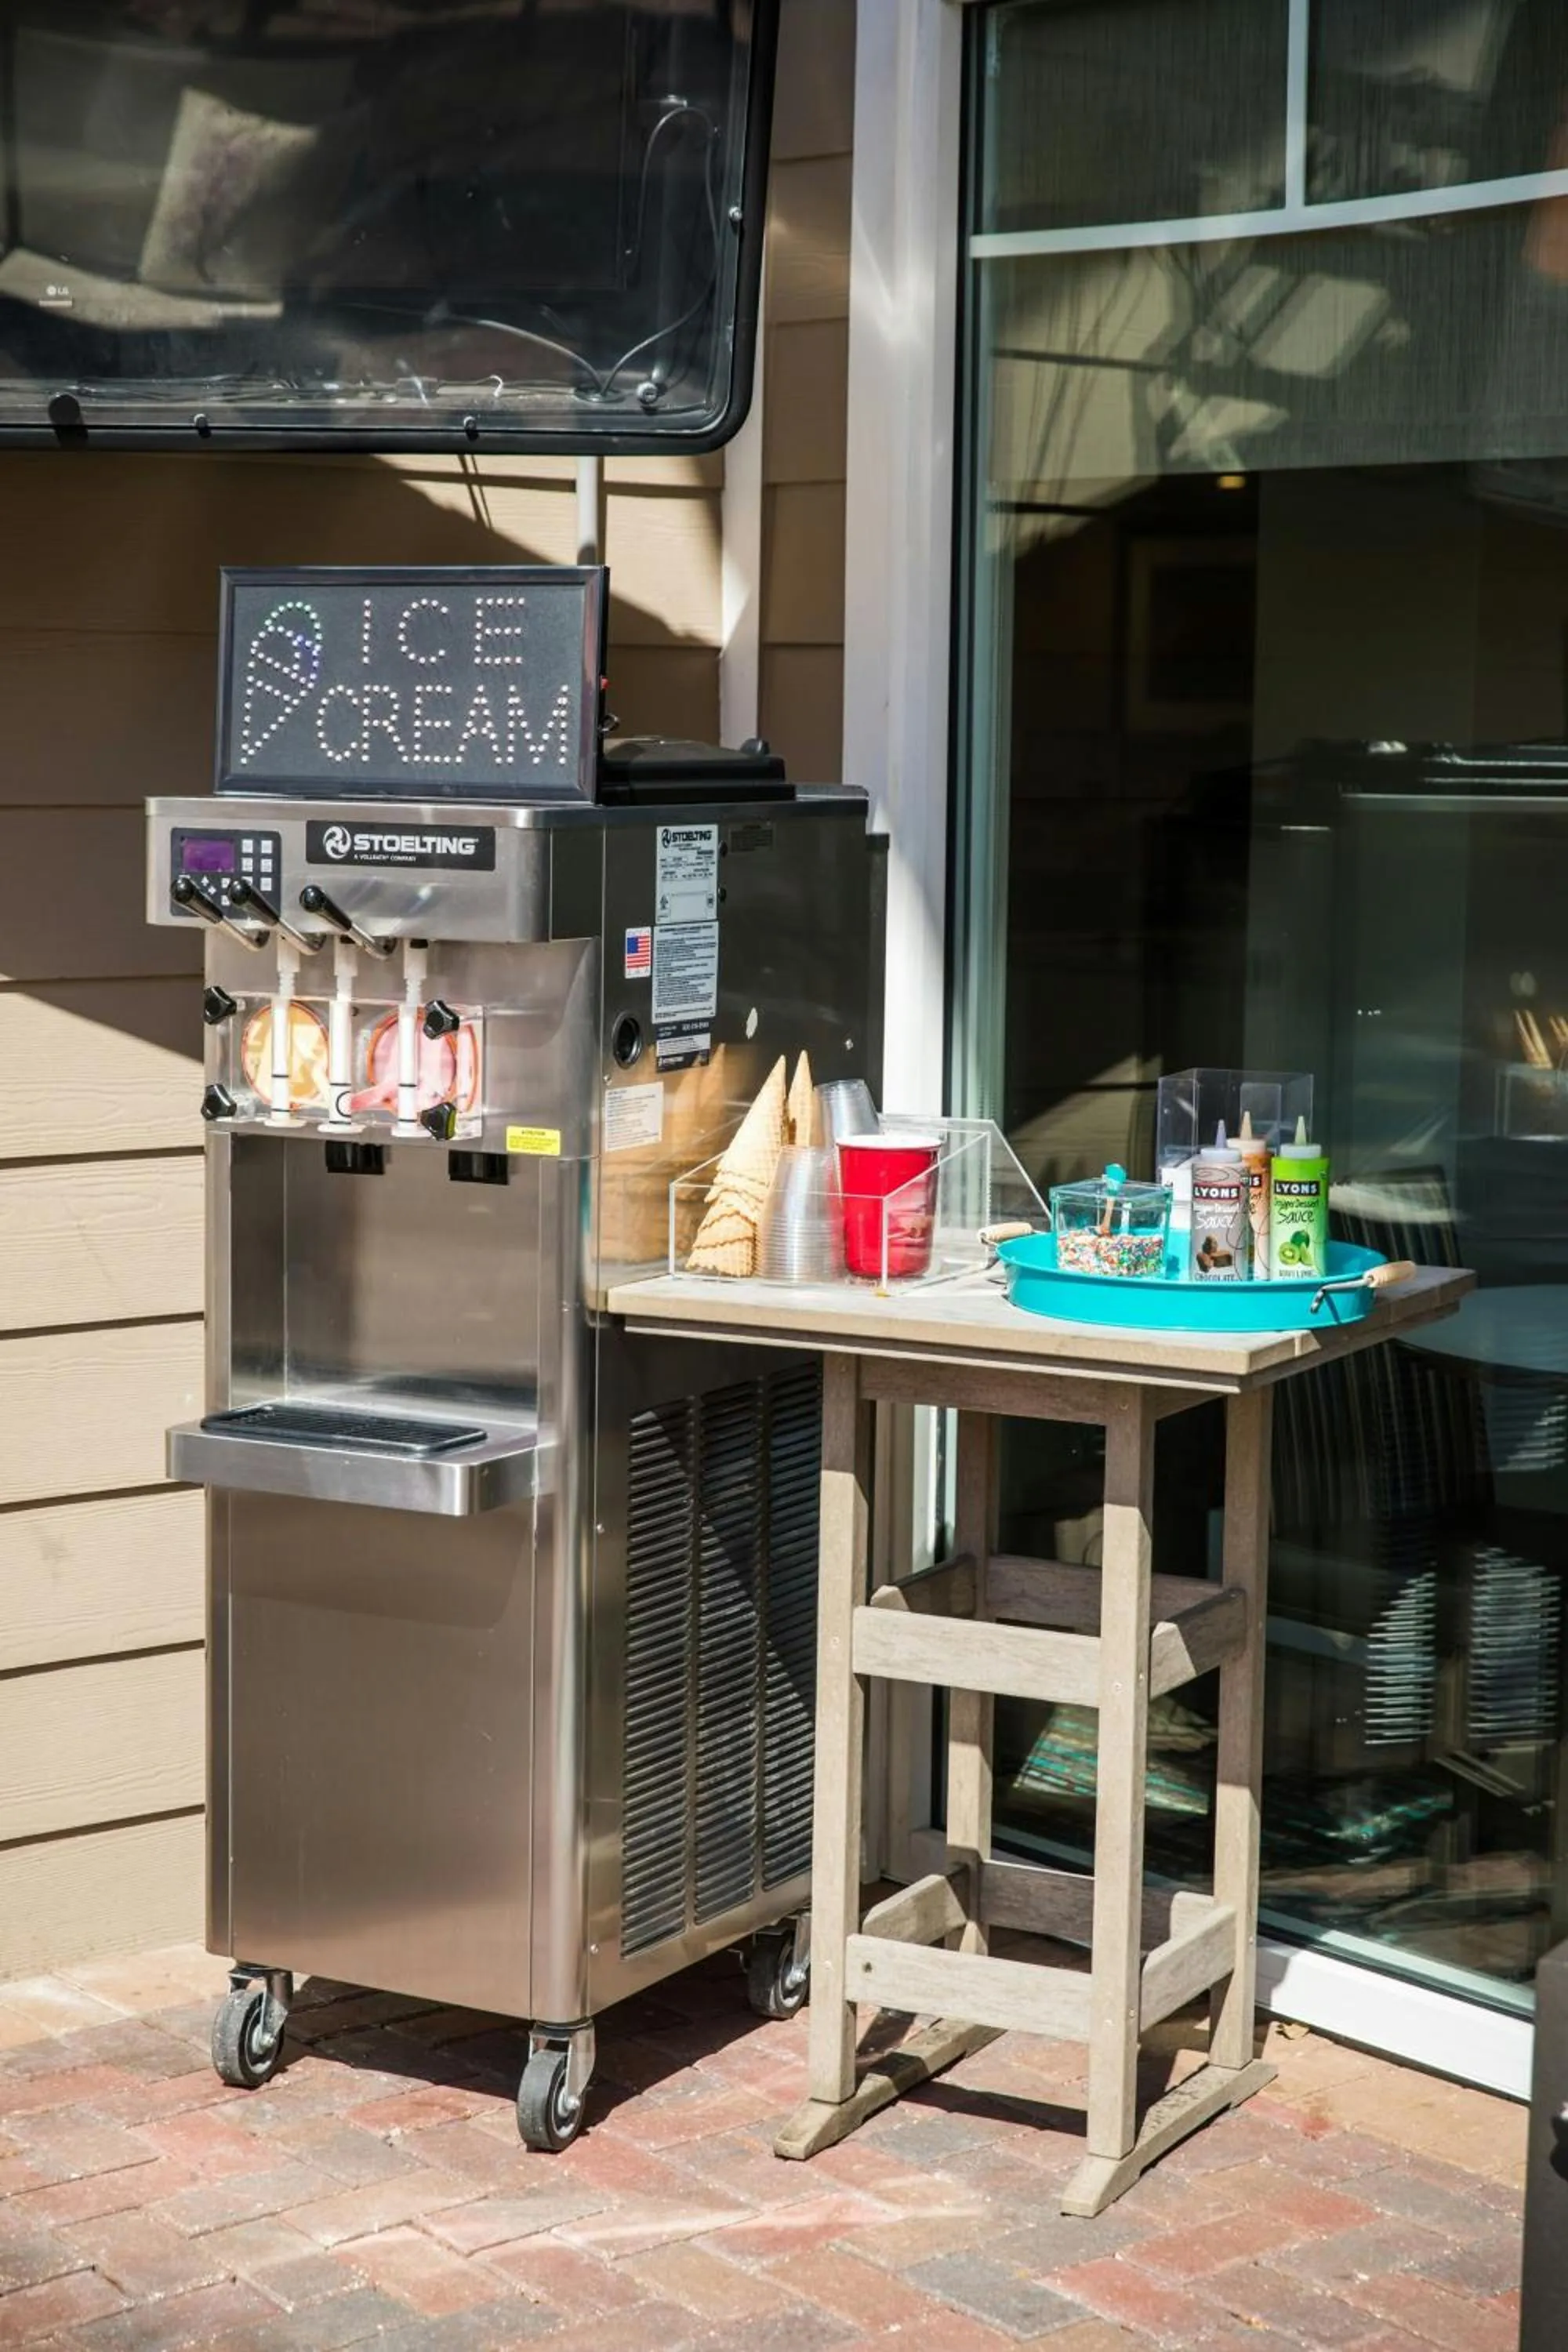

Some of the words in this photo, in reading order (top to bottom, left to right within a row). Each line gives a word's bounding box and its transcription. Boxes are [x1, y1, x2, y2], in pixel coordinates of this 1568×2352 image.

[362, 597, 525, 665] ICE
[316, 684, 569, 765] CREAM
[354, 833, 477, 855] STOELTING
[1194, 1187, 1239, 1198] LYONS
[1276, 1183, 1318, 1194] LYONS
